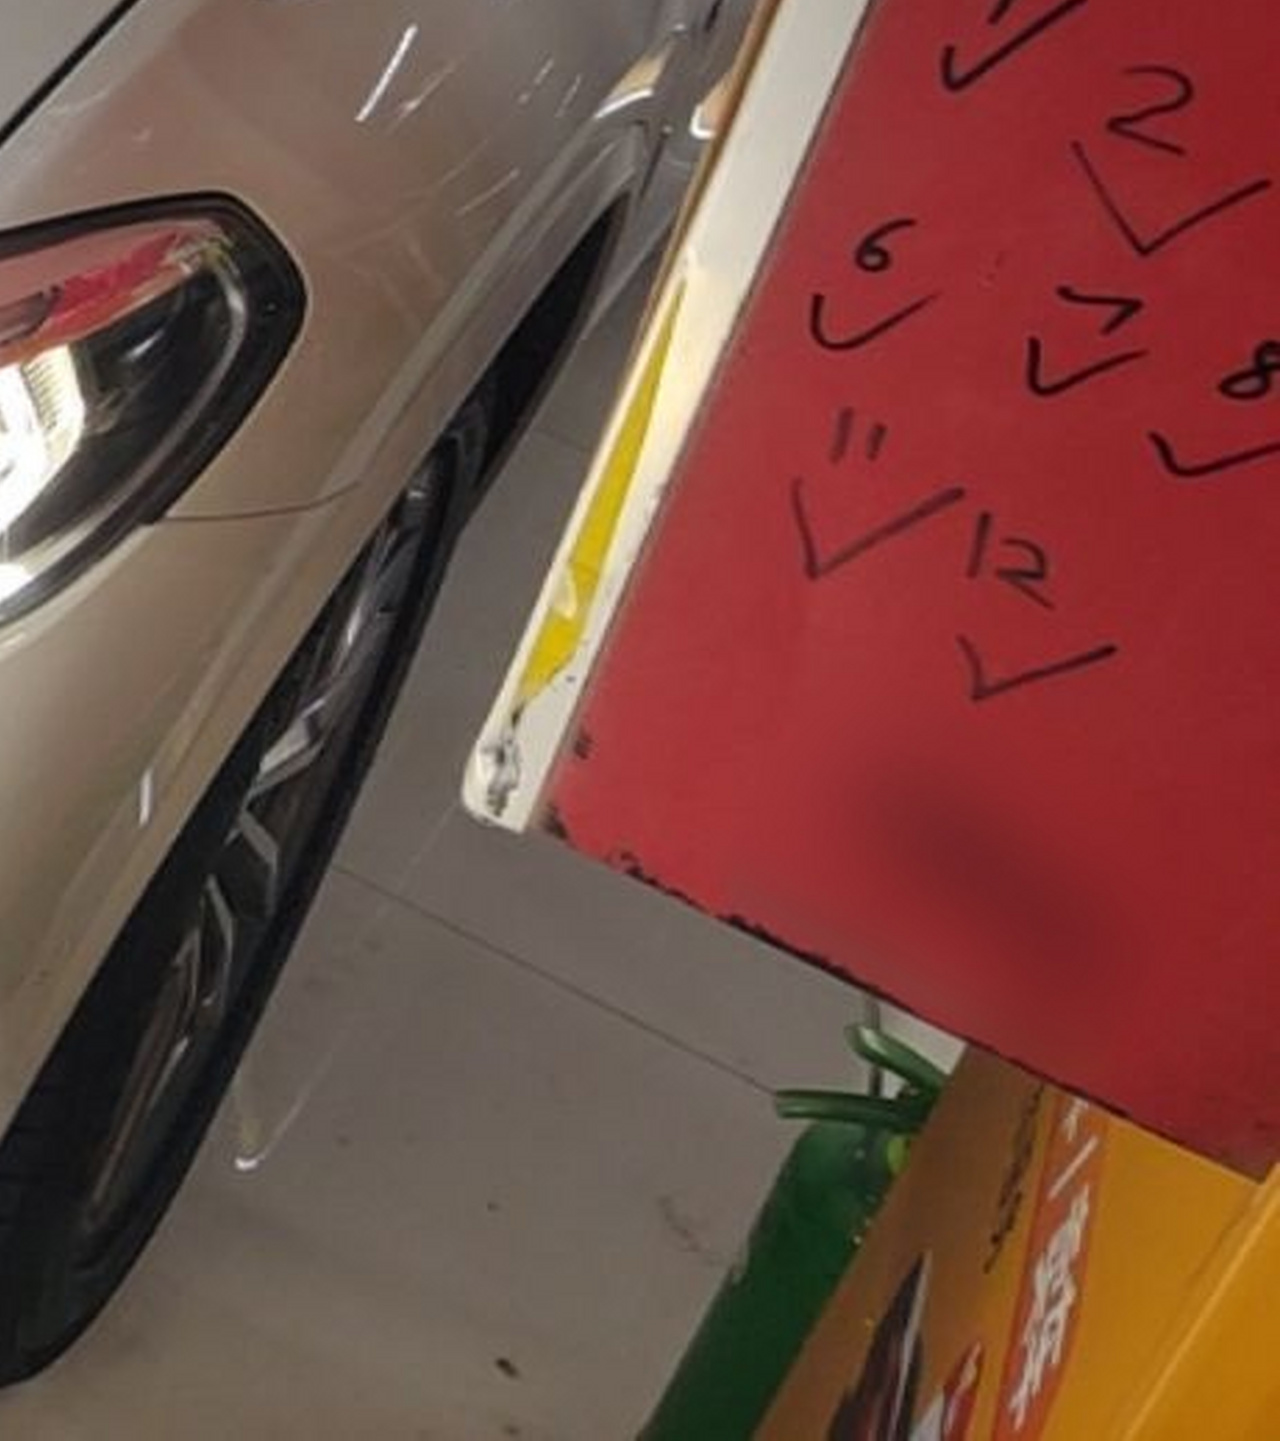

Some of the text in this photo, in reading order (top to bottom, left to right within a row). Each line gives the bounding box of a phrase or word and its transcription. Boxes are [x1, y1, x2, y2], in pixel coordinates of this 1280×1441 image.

[1105, 65, 1195, 157] 2
[853, 217, 1280, 402] 6 7 8
[967, 510, 1053, 609] 12
